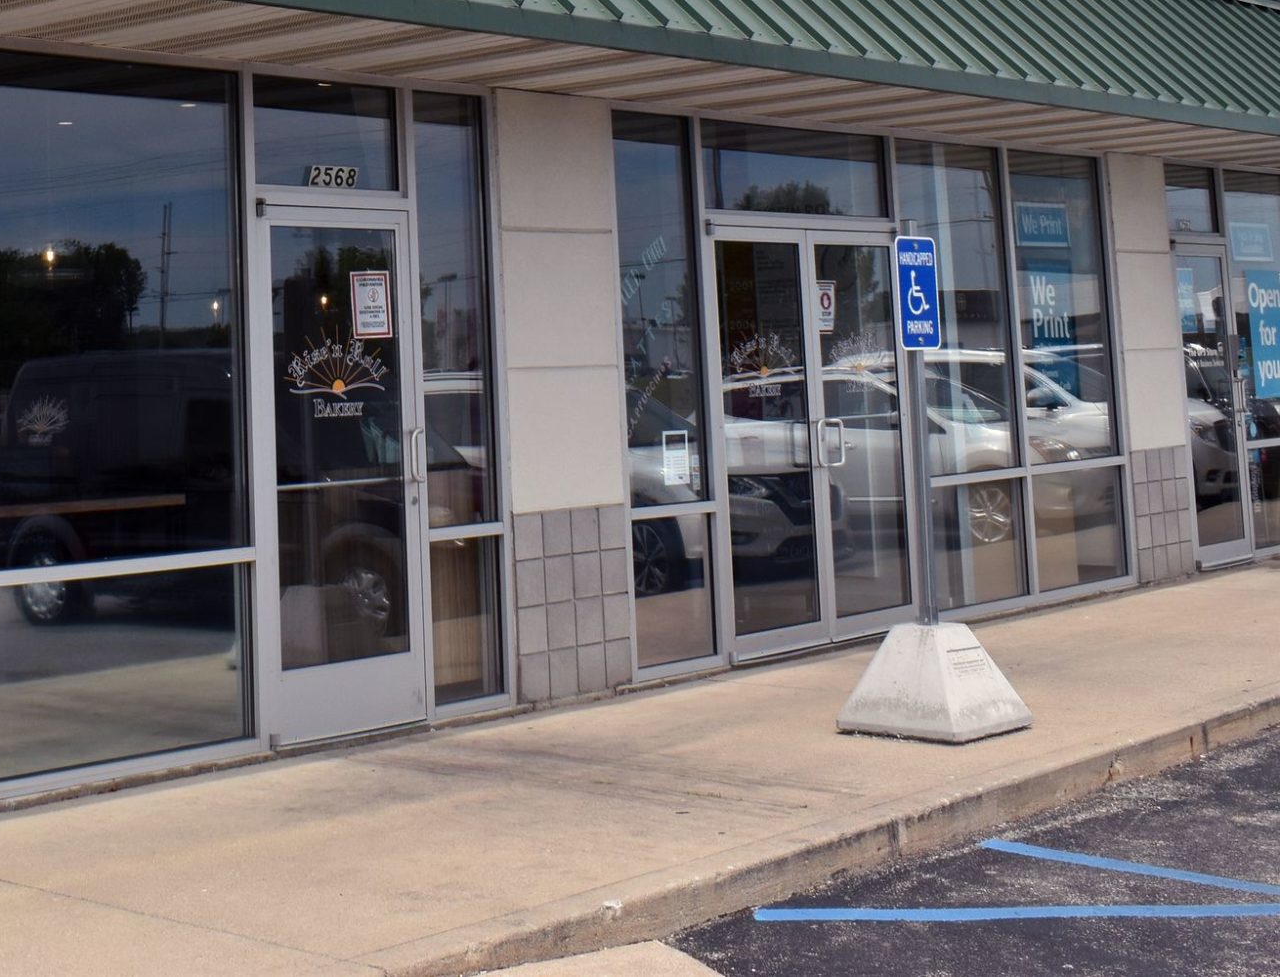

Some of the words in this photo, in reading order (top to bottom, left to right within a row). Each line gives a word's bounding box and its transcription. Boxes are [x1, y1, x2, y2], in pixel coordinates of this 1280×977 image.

[309, 166, 357, 188] 2568
[1021, 213, 1038, 235] We
[1039, 214, 1062, 237] Print
[898, 251, 933, 266] HANDICAPPED
[1029, 275, 1056, 306] We
[1248, 282, 1280, 314] Open
[907, 320, 934, 335] PARKING
[1032, 308, 1070, 340] Print
[1259, 319, 1277, 346] for
[1257, 360, 1280, 387] you
[313, 399, 364, 418] BAKERY
